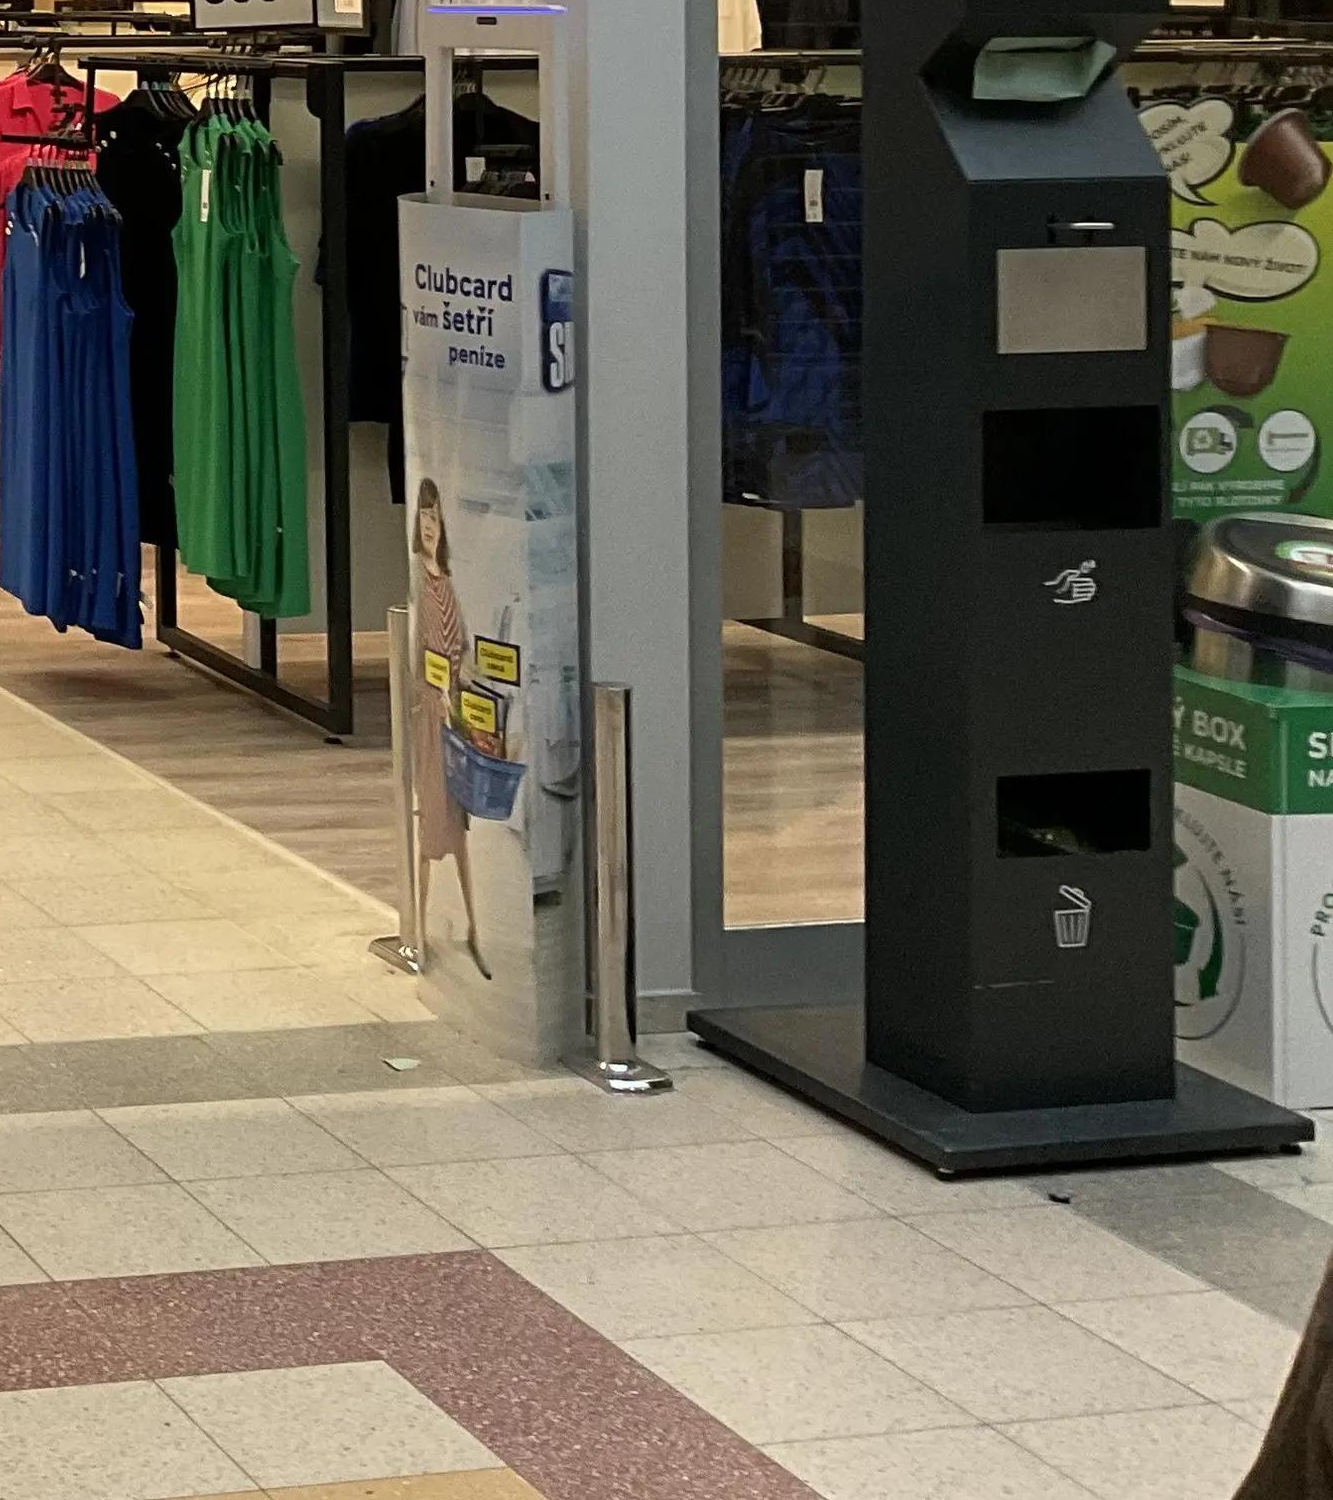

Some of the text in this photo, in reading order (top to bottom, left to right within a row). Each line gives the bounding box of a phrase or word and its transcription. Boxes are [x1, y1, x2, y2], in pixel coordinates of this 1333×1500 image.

[415, 263, 514, 302] Clubcard
[413, 301, 496, 337] vám šetří
[449, 345, 506, 370] peníze
[1191, 709, 1247, 751] BOX
